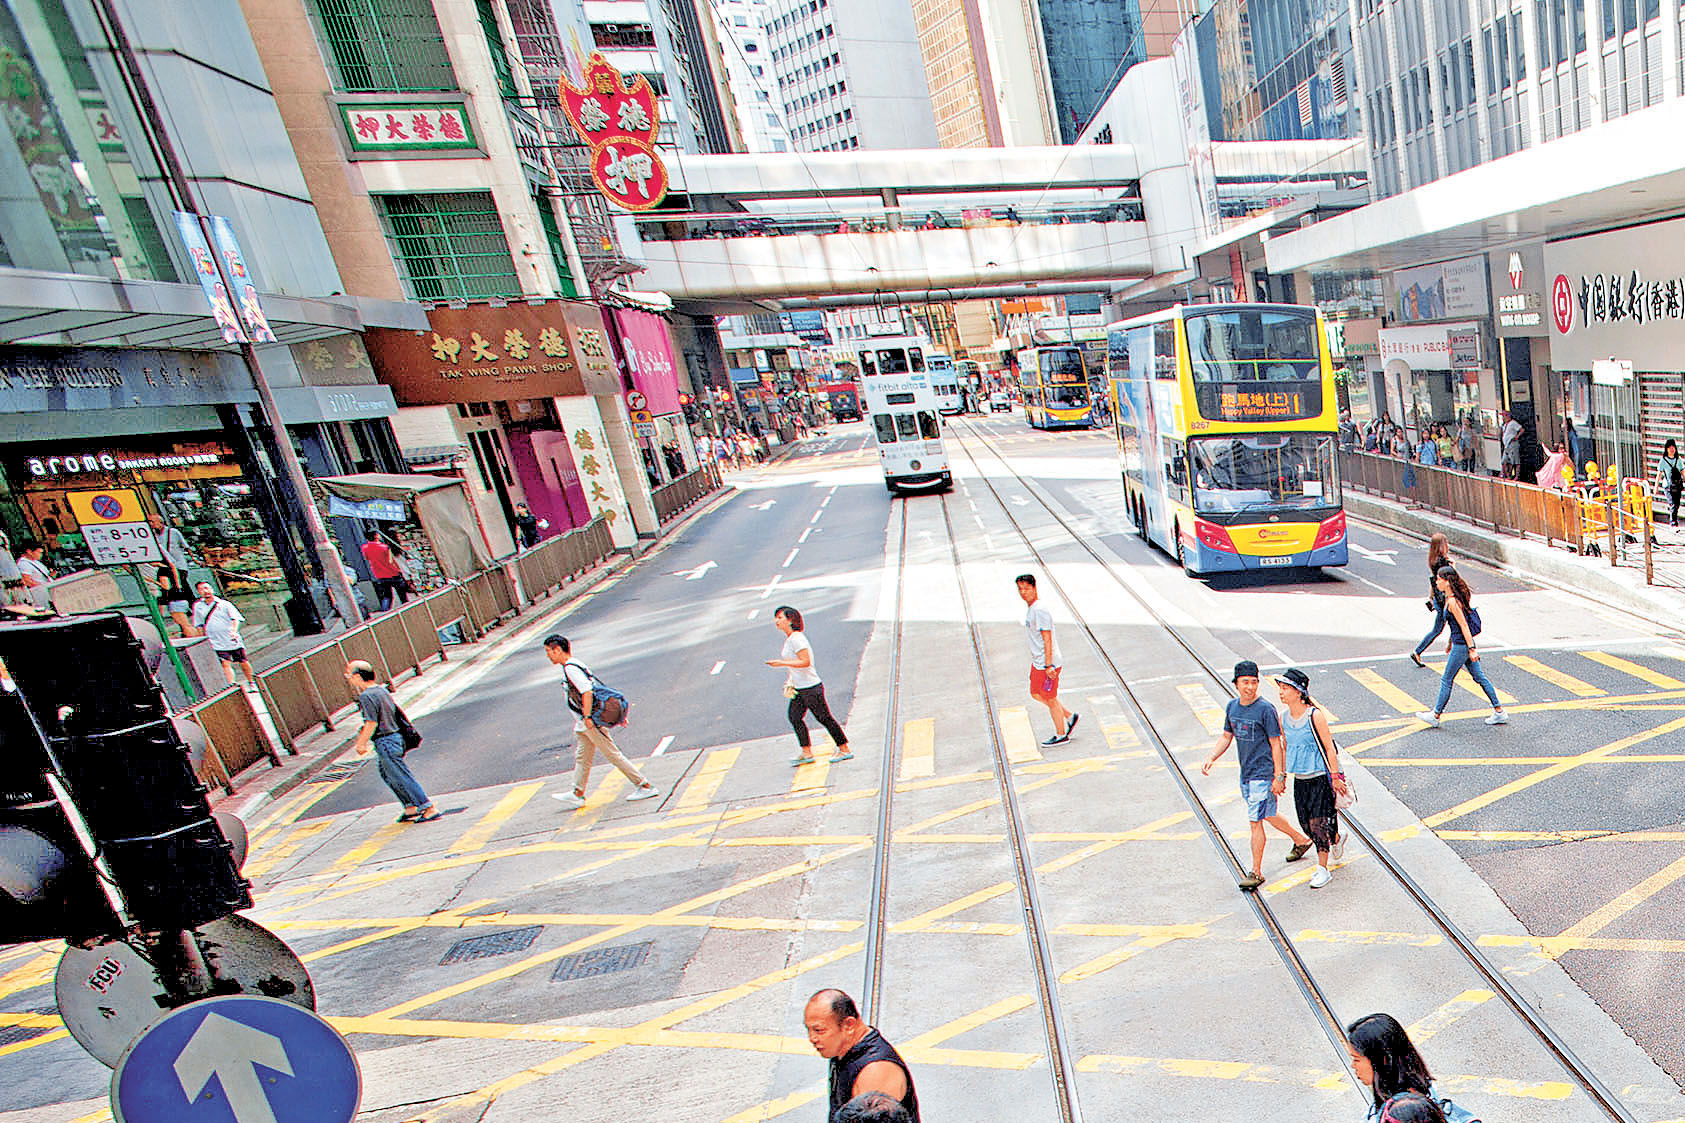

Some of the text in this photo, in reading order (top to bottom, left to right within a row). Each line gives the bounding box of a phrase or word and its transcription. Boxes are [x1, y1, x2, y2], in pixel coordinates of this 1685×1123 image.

[604, 146, 654, 199] 押
[440, 362, 573, 379] TAK WING PAWN SHOP
[1293, 393, 1300, 415] 1
[28, 452, 116, 476] arome
[110, 527, 150, 541] 8-10
[118, 546, 149, 558] 5-7
